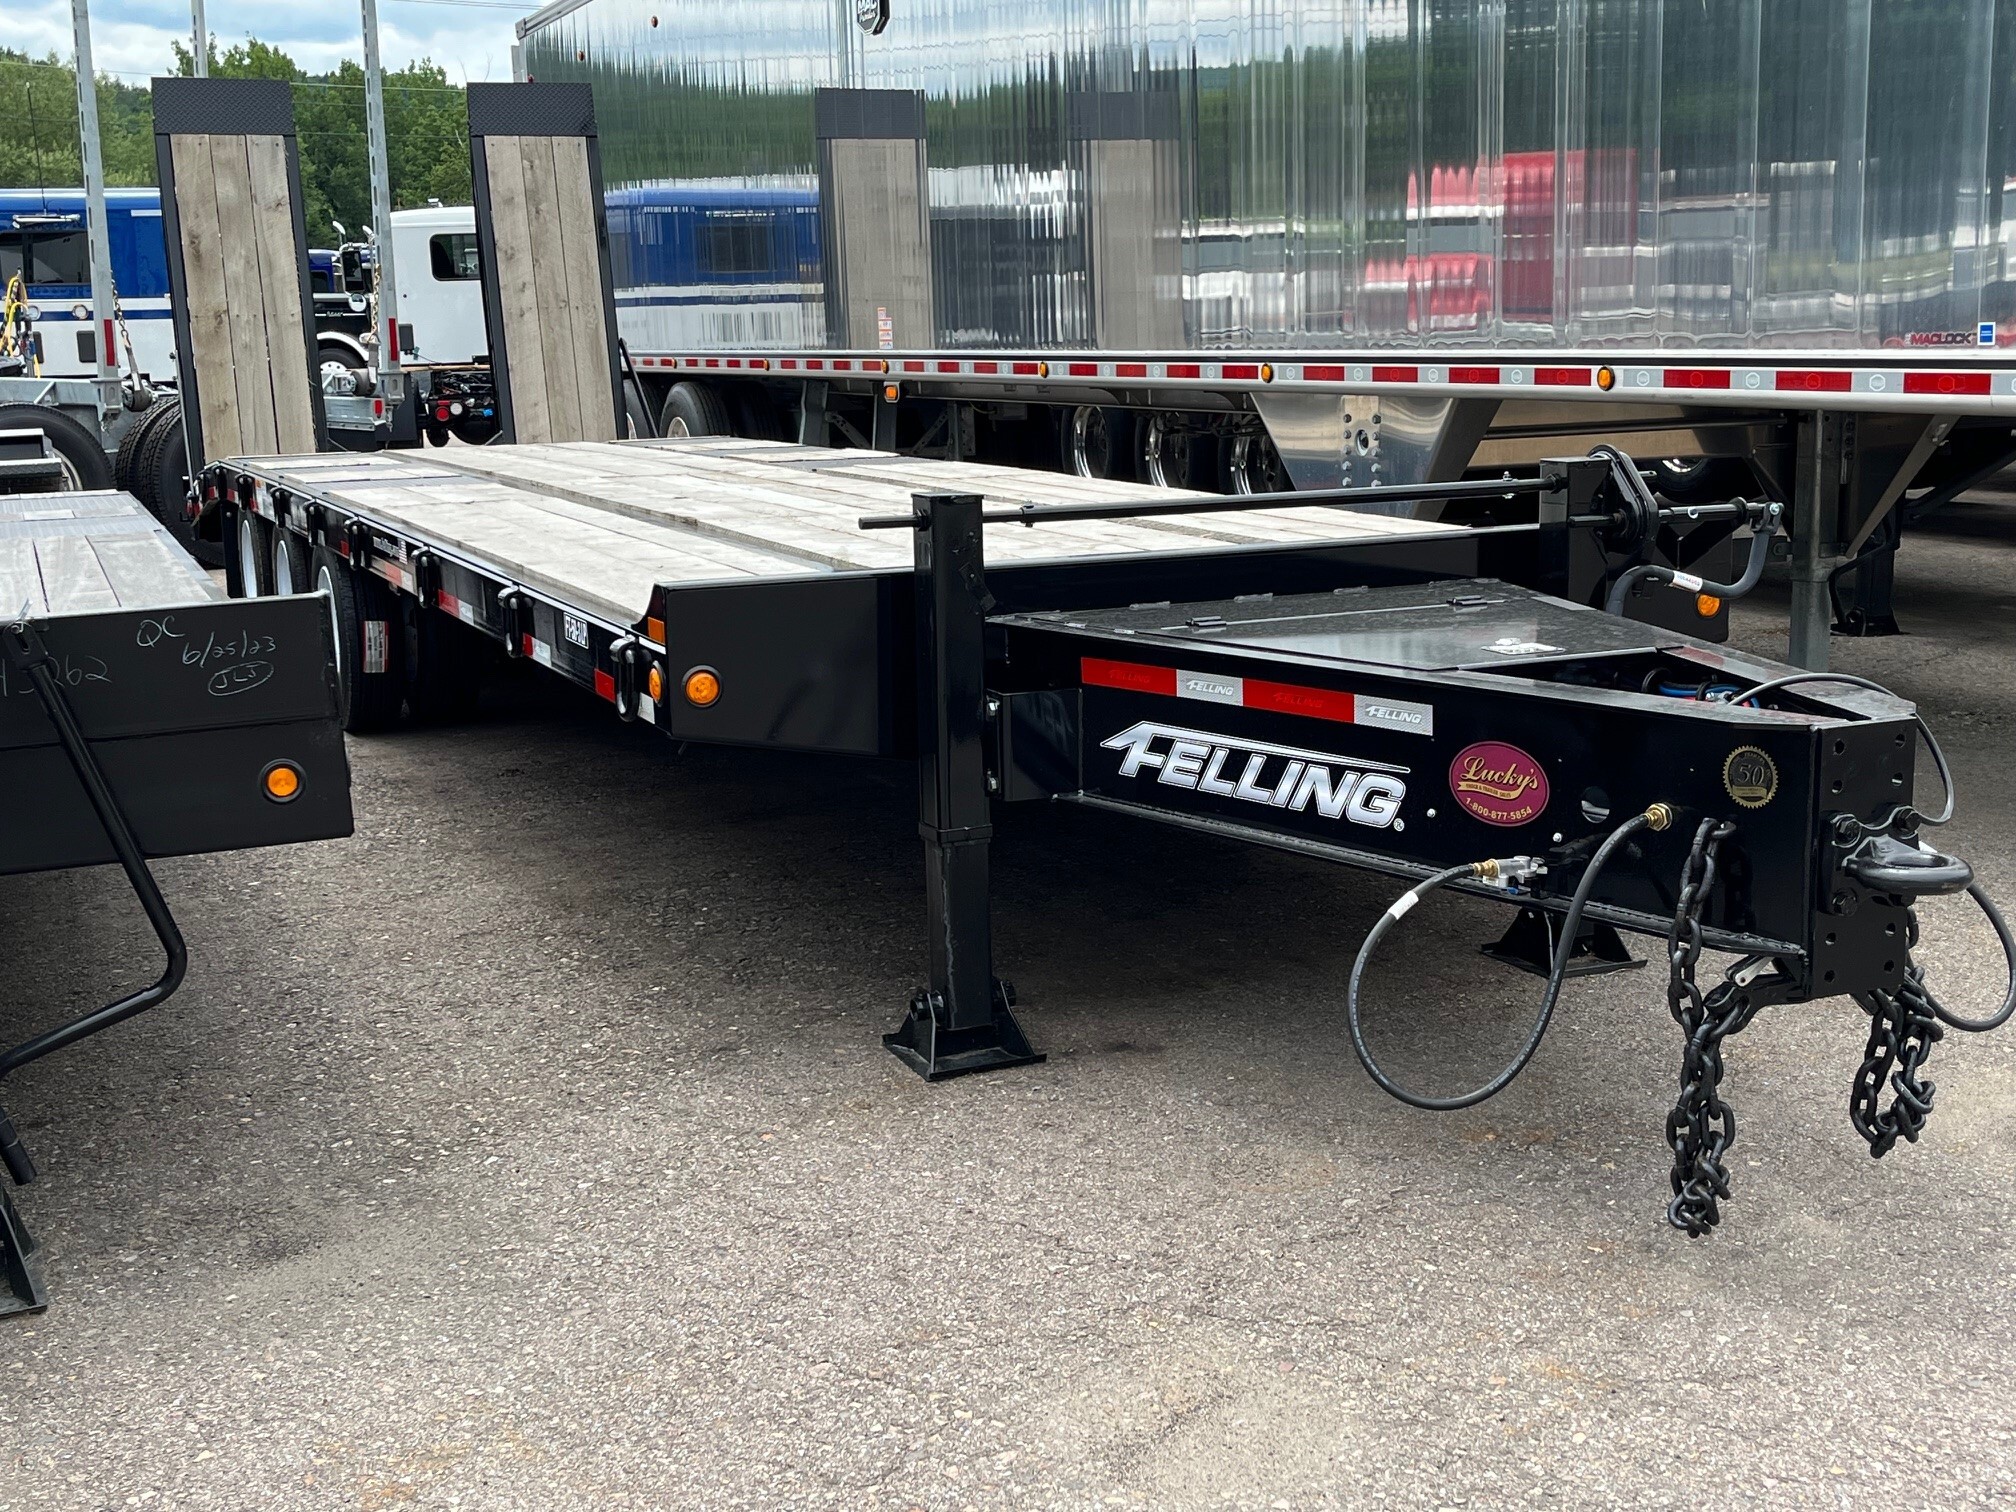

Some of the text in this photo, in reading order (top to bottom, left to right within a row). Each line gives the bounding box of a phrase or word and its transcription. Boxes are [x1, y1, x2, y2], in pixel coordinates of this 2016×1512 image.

[136, 616, 185, 648] QC
[182, 630, 276, 668] 6/25/23
[1186, 680, 1234, 696] FELLING
[1364, 705, 1422, 724] FELLING
[1101, 720, 1410, 829] FELLING
[1461, 756, 1538, 790] Lucky's
[1737, 763, 1764, 786] 50
[1465, 797, 1532, 820] 1-800-877-5854
